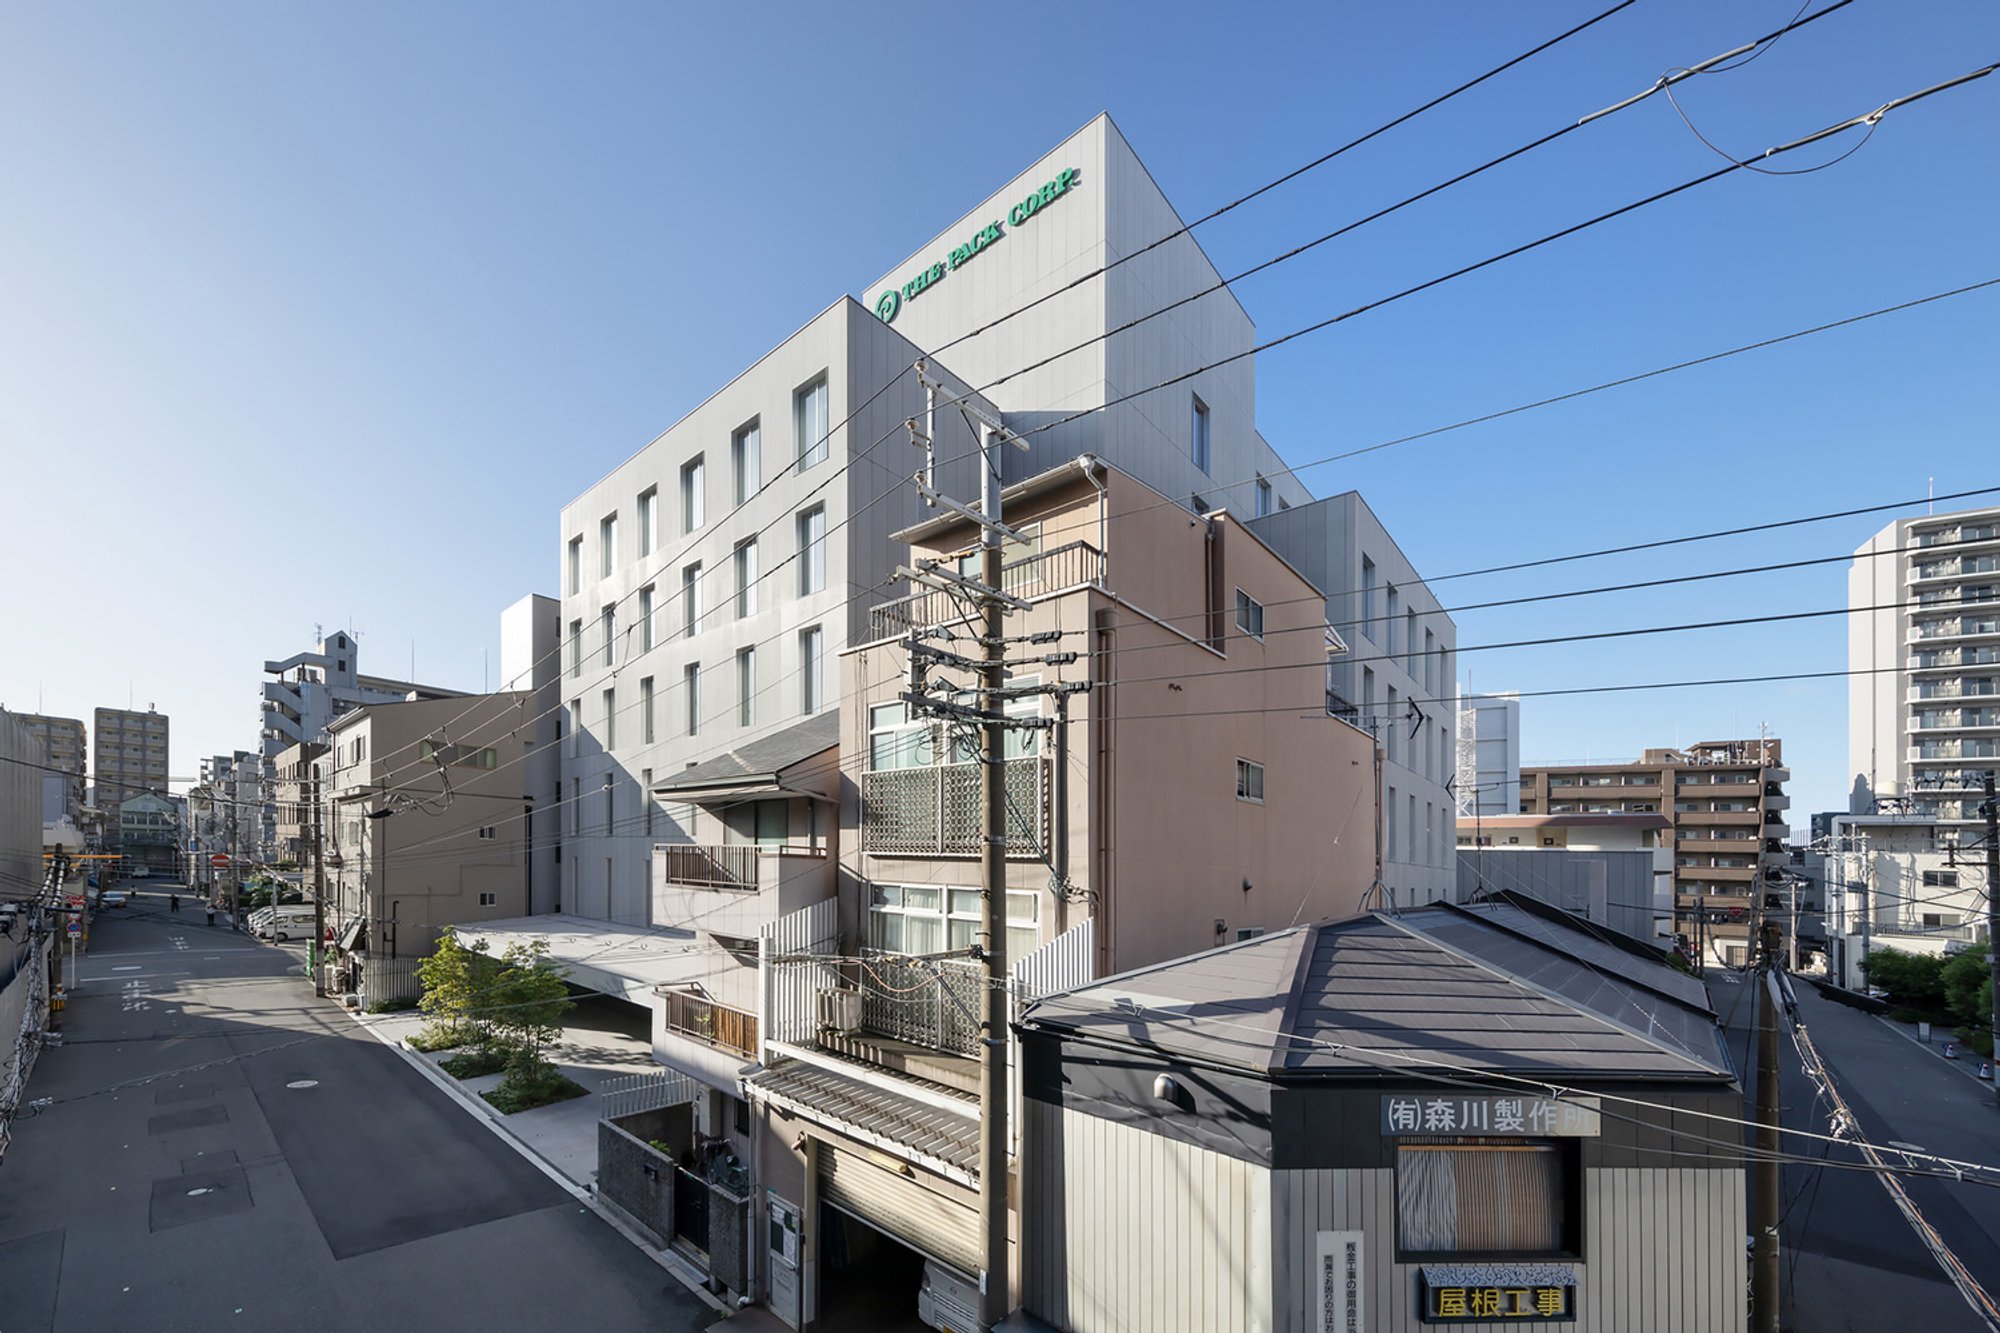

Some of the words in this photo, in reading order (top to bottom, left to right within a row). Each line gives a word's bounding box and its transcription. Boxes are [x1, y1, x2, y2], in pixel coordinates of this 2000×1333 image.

[901, 260, 942, 301] THE
[947, 220, 1000, 271] PACK
[1007, 167, 1075, 226] CORP.
[1388, 1098, 1590, 1132] (有)森川製作所
[1438, 1288, 1562, 1316] 屋根工事
